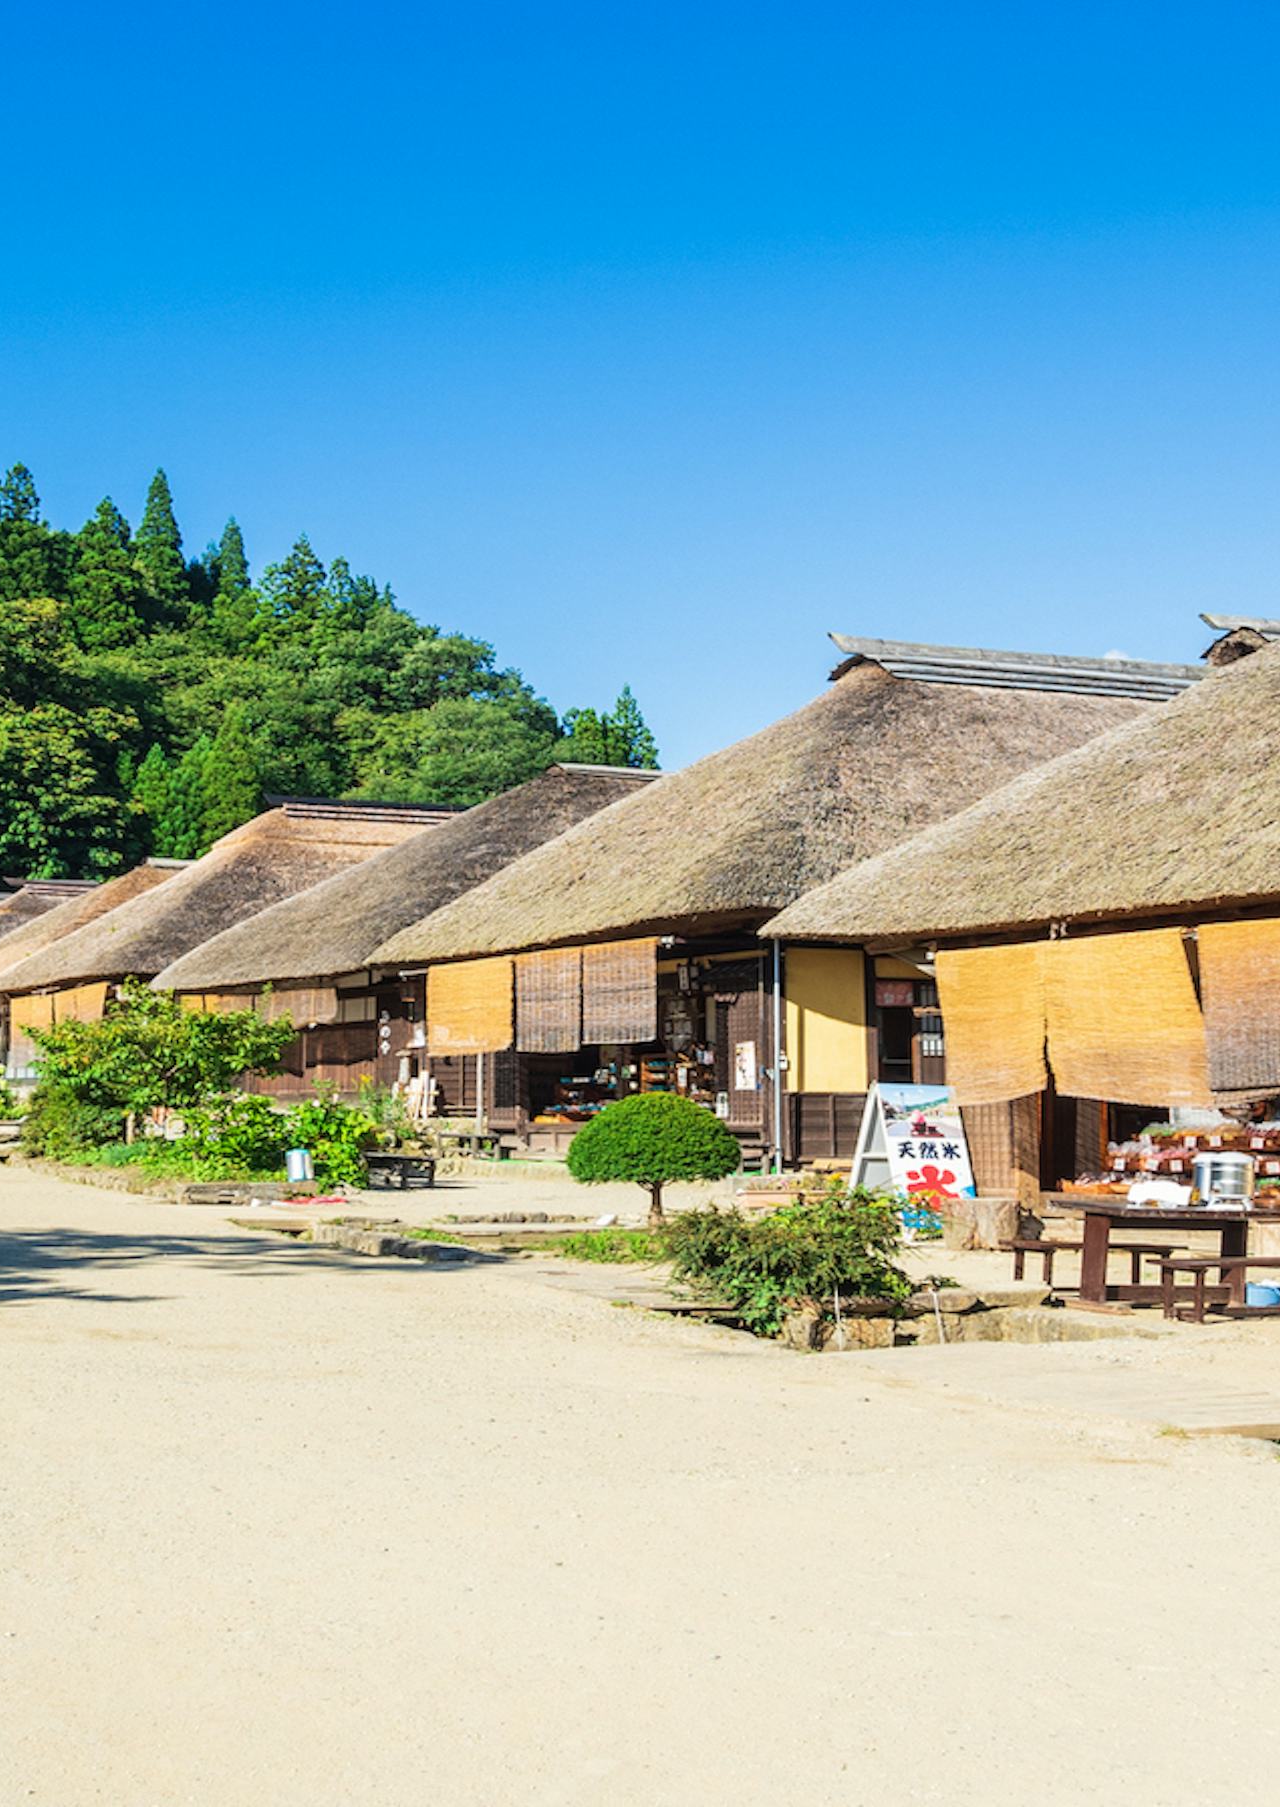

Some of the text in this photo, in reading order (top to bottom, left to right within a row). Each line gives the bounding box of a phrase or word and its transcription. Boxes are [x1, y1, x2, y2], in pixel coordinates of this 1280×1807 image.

[897, 1140, 961, 1160] 天然氷
[906, 1164, 961, 1212] 氷
